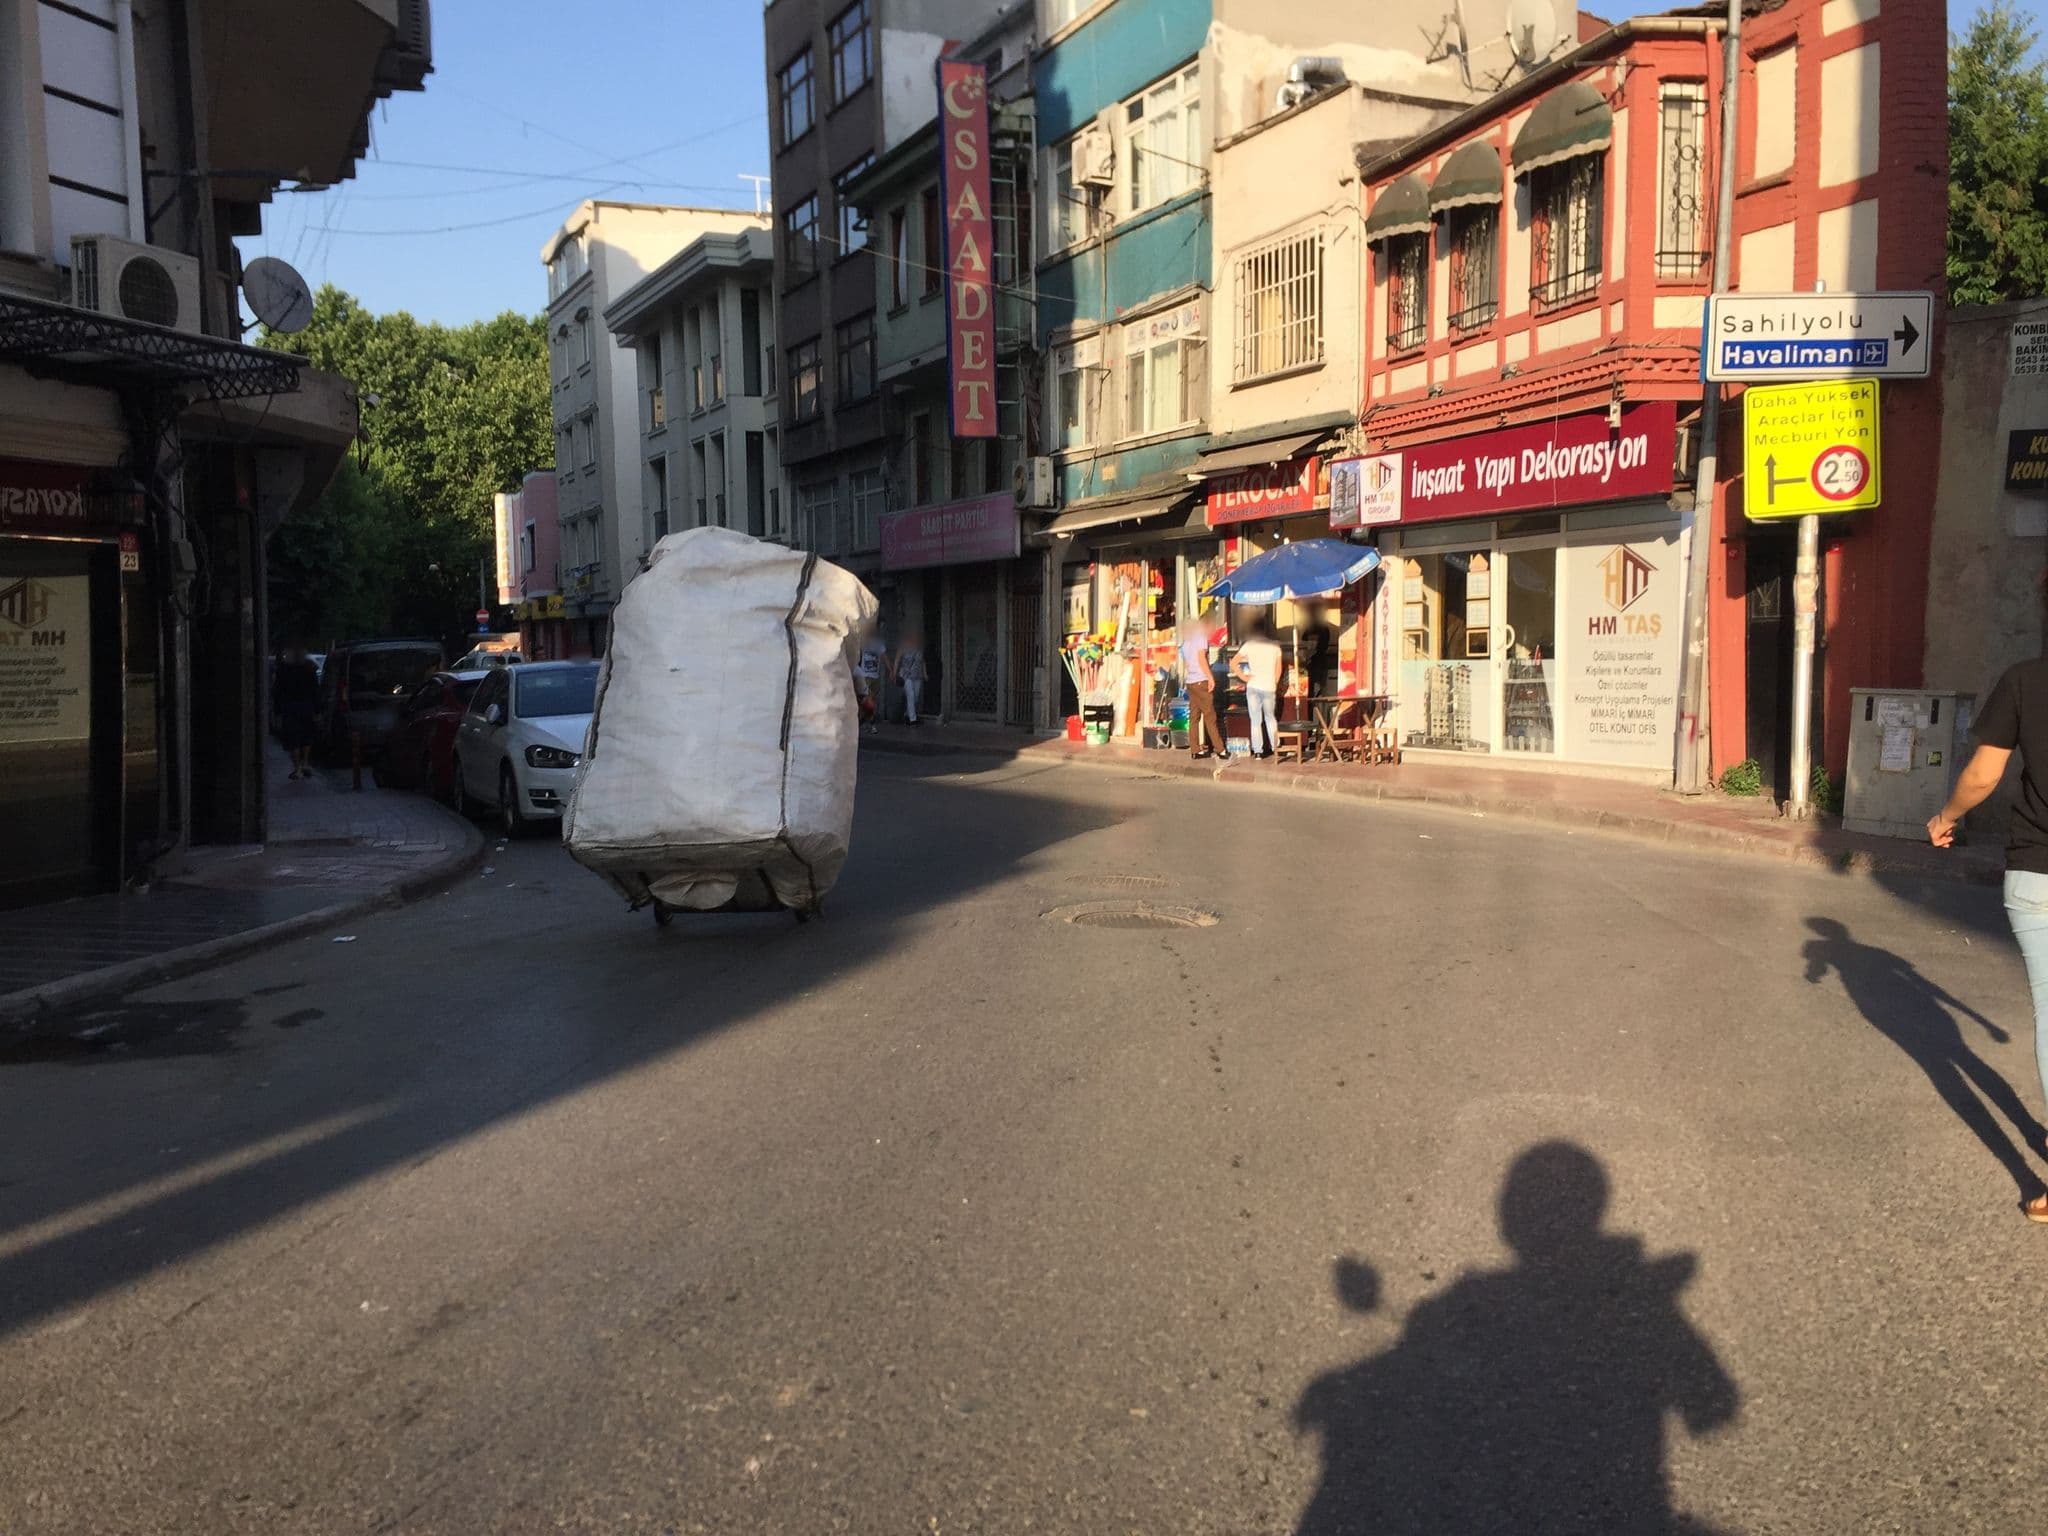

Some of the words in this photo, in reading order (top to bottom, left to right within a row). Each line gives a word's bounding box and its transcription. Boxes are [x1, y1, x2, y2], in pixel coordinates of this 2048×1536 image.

[952, 129, 989, 420] SAADET
[1723, 311, 1863, 335] Sahilyolu
[1724, 344, 1861, 365] Havalimanı
[1752, 396, 1797, 409] Daha
[1758, 412, 1825, 427] Araçlar
[1754, 431, 1828, 446] Mecburi
[1411, 459, 1466, 501] İnşaat
[1475, 455, 1515, 497] Yapı
[1520, 433, 1648, 484] Dekorasyon
[123, 554, 136, 568] 23
[1588, 616, 1617, 636] HM
[1623, 613, 1662, 640] TAŞ
[1589, 722, 1609, 733] OTEL
[1610, 722, 1636, 734] KONUT
